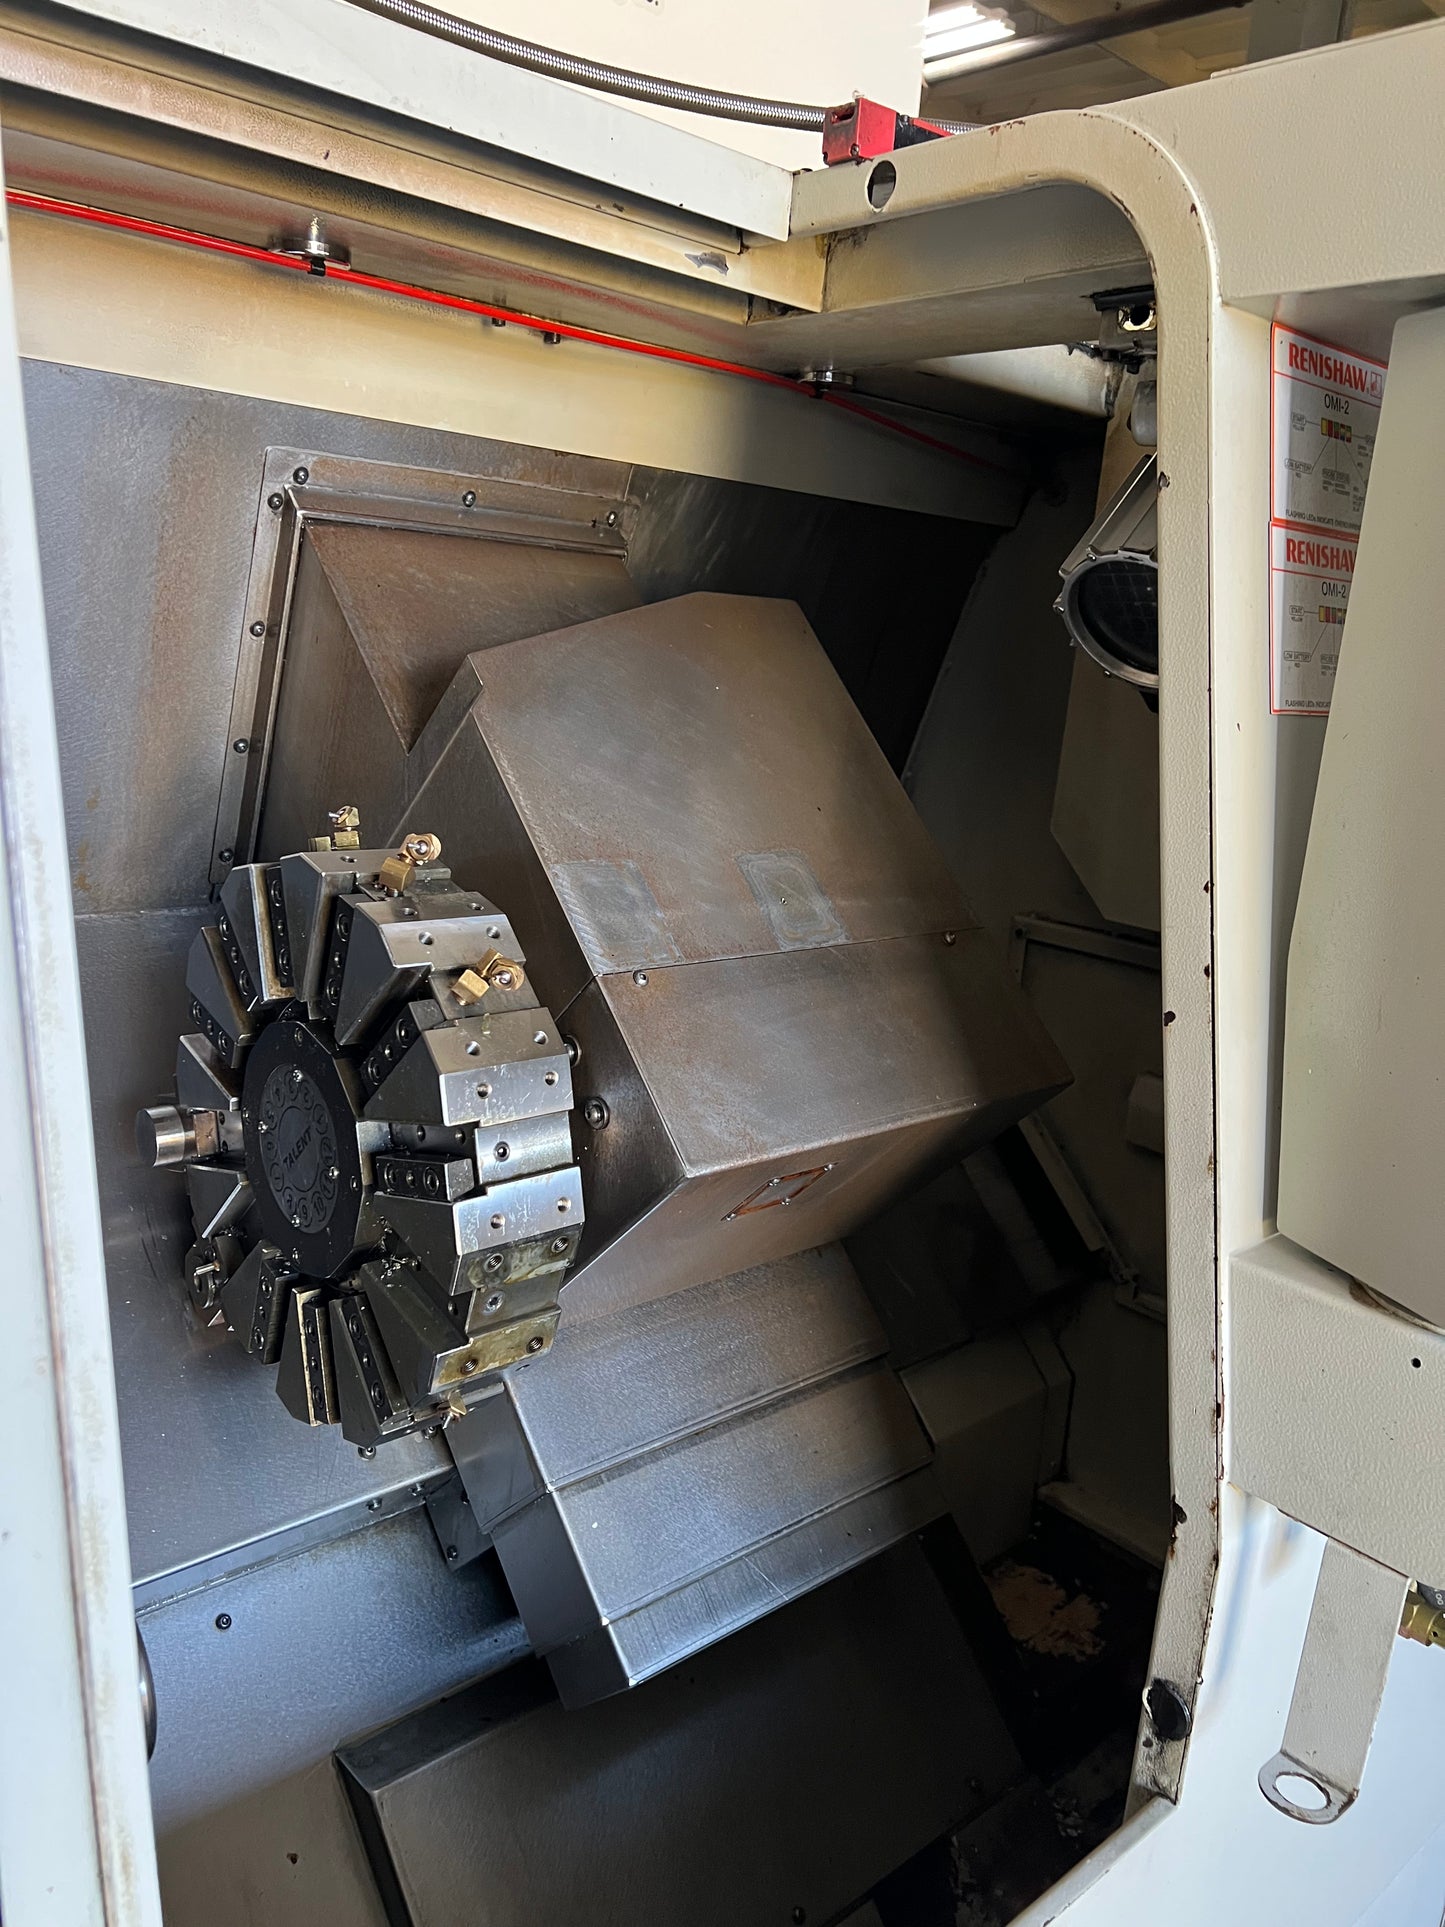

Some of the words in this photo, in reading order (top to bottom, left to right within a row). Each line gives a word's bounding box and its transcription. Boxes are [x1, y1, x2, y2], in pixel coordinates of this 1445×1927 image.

[1289, 342, 1367, 393] RENISHAW
[1324, 393, 1350, 415] OMI-2
[1321, 581, 1347, 598] OMI-2
[283, 1126, 312, 1168] TALENT
[301, 1203, 309, 1220] 9
[313, 1195, 325, 1216] 10
